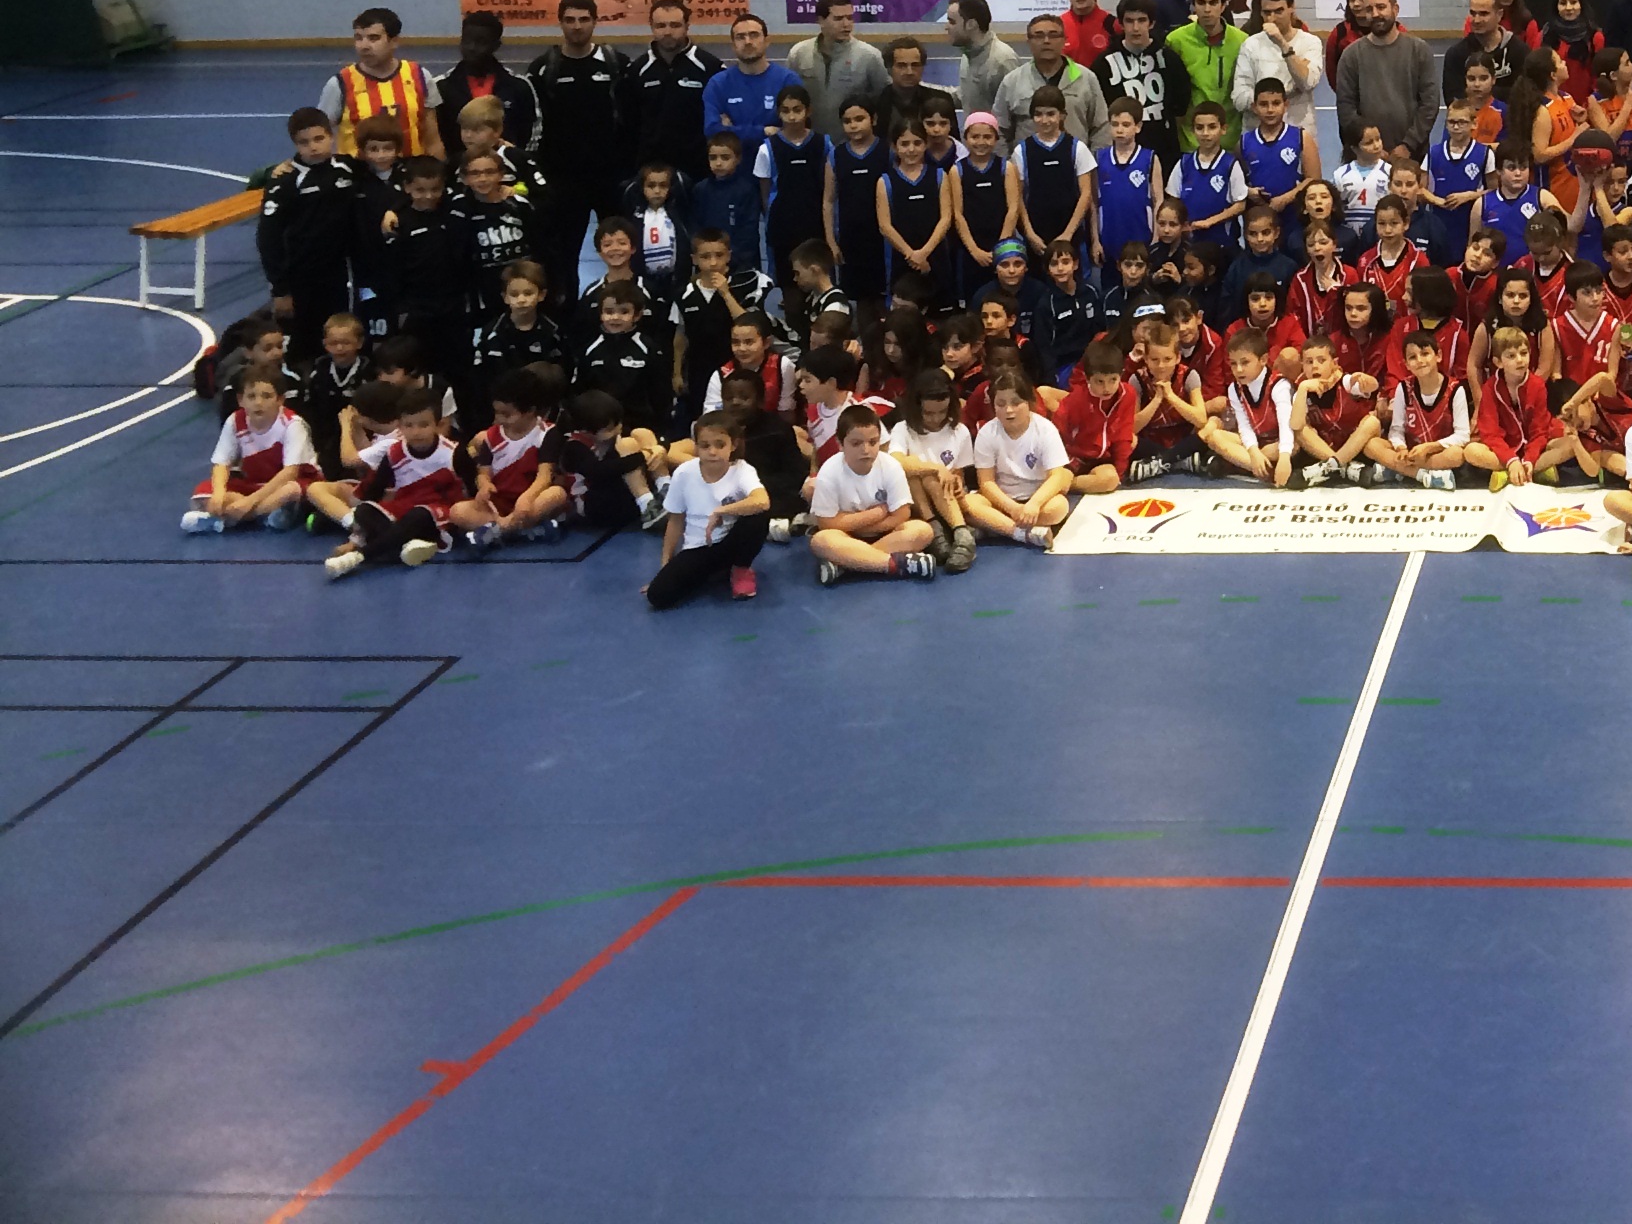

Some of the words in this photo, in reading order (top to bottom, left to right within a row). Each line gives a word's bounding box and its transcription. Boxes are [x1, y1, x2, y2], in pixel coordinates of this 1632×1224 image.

[1123, 72, 1165, 107] DO
[1357, 188, 1368, 206] 4
[650, 227, 660, 244] 6
[1212, 502, 1349, 513] Federació
[1363, 502, 1485, 513] Catalana
[1243, 514, 1276, 524] de
